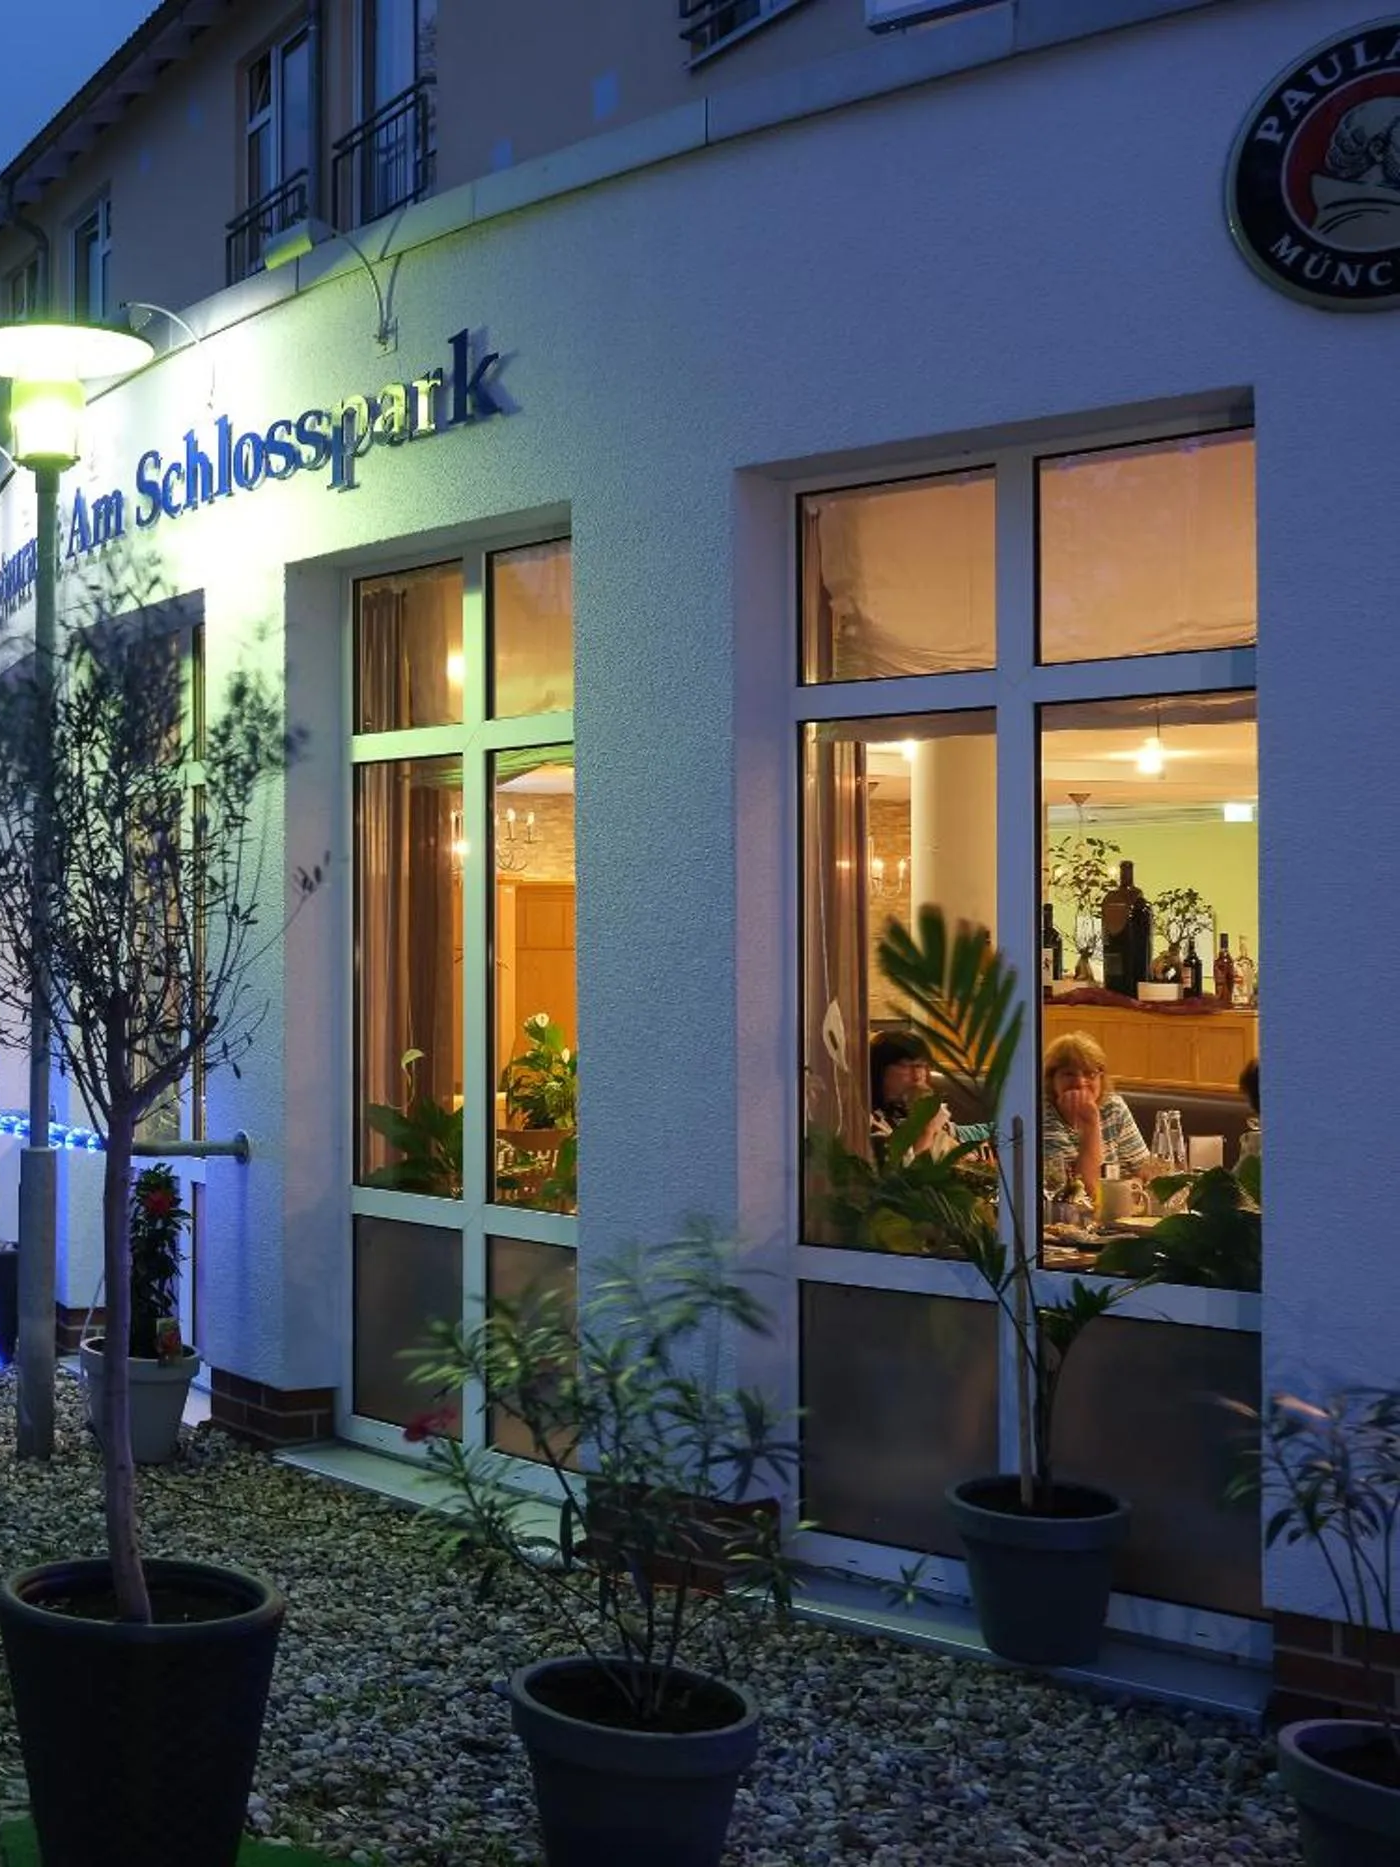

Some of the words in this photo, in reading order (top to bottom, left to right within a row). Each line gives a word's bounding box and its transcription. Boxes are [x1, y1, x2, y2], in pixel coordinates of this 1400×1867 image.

[1269, 233, 1393, 287] MÜNC
[65, 487, 126, 559] Am
[135, 328, 503, 528] Schlosspark
